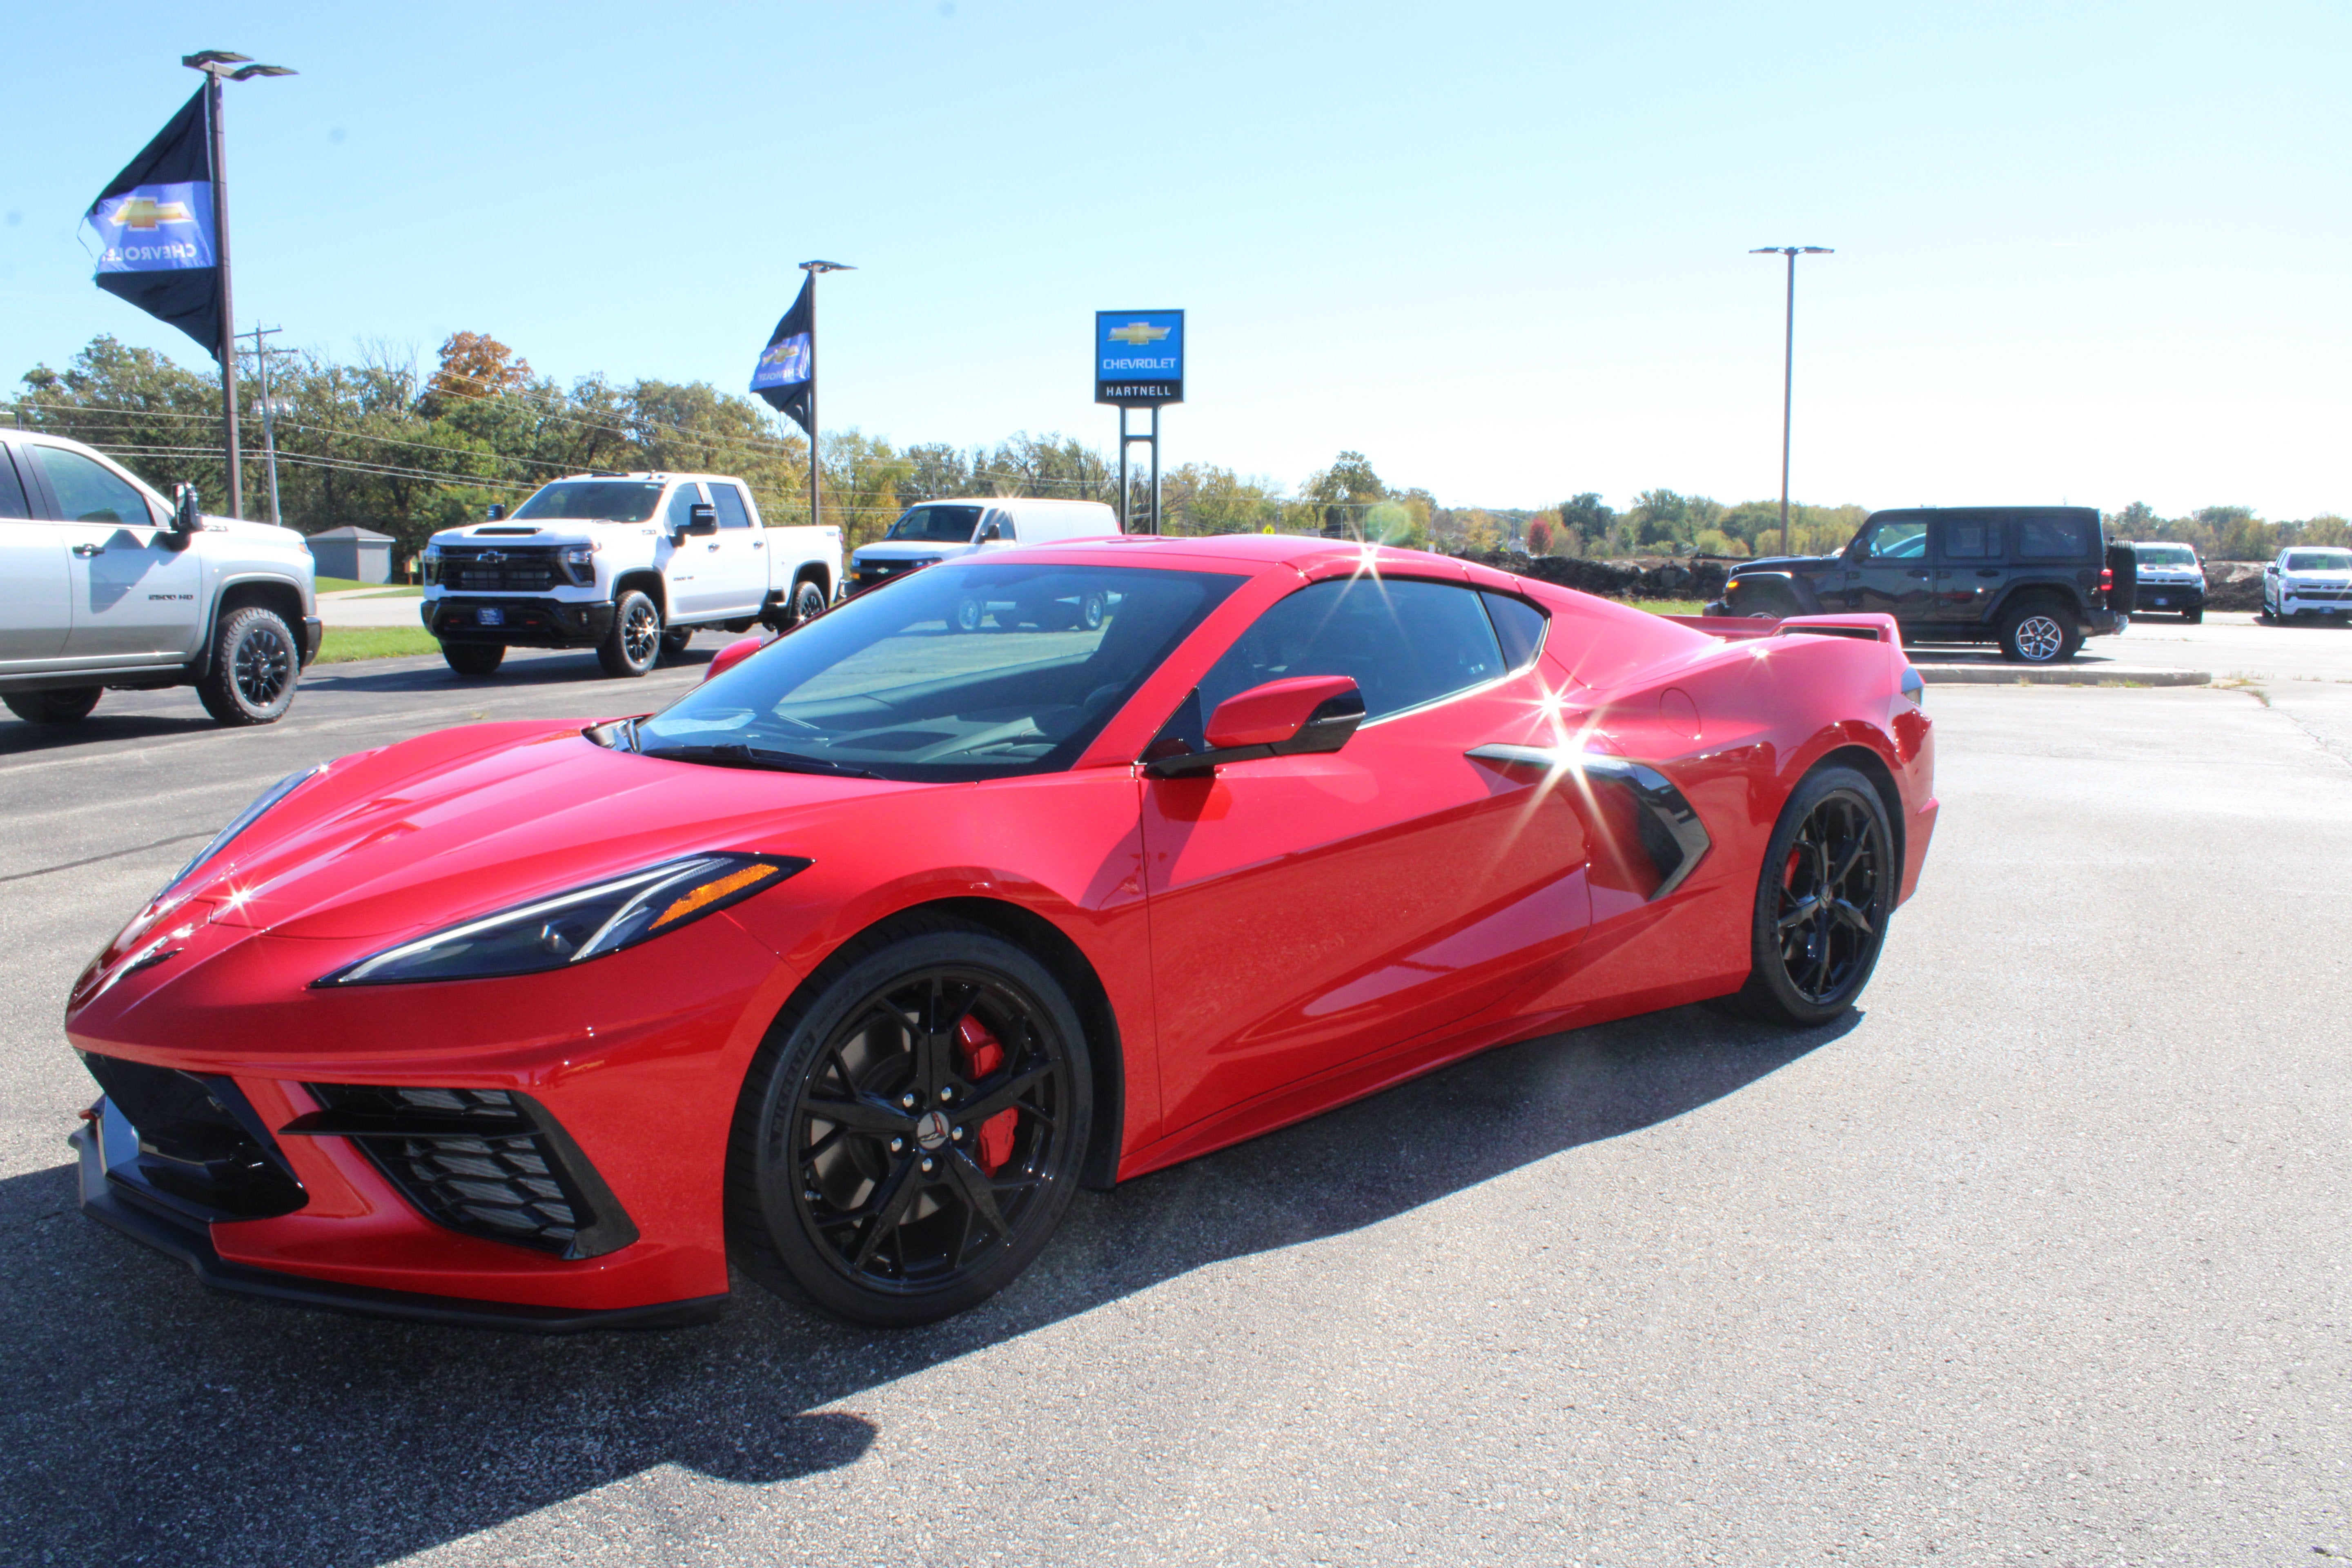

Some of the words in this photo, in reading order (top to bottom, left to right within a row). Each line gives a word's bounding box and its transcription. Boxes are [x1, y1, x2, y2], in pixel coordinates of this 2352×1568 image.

[1103, 358, 1176, 369] CHEVROLET
[1106, 386, 1172, 396] HARTNELL
[772, 1036, 813, 1134] MICHELIN
